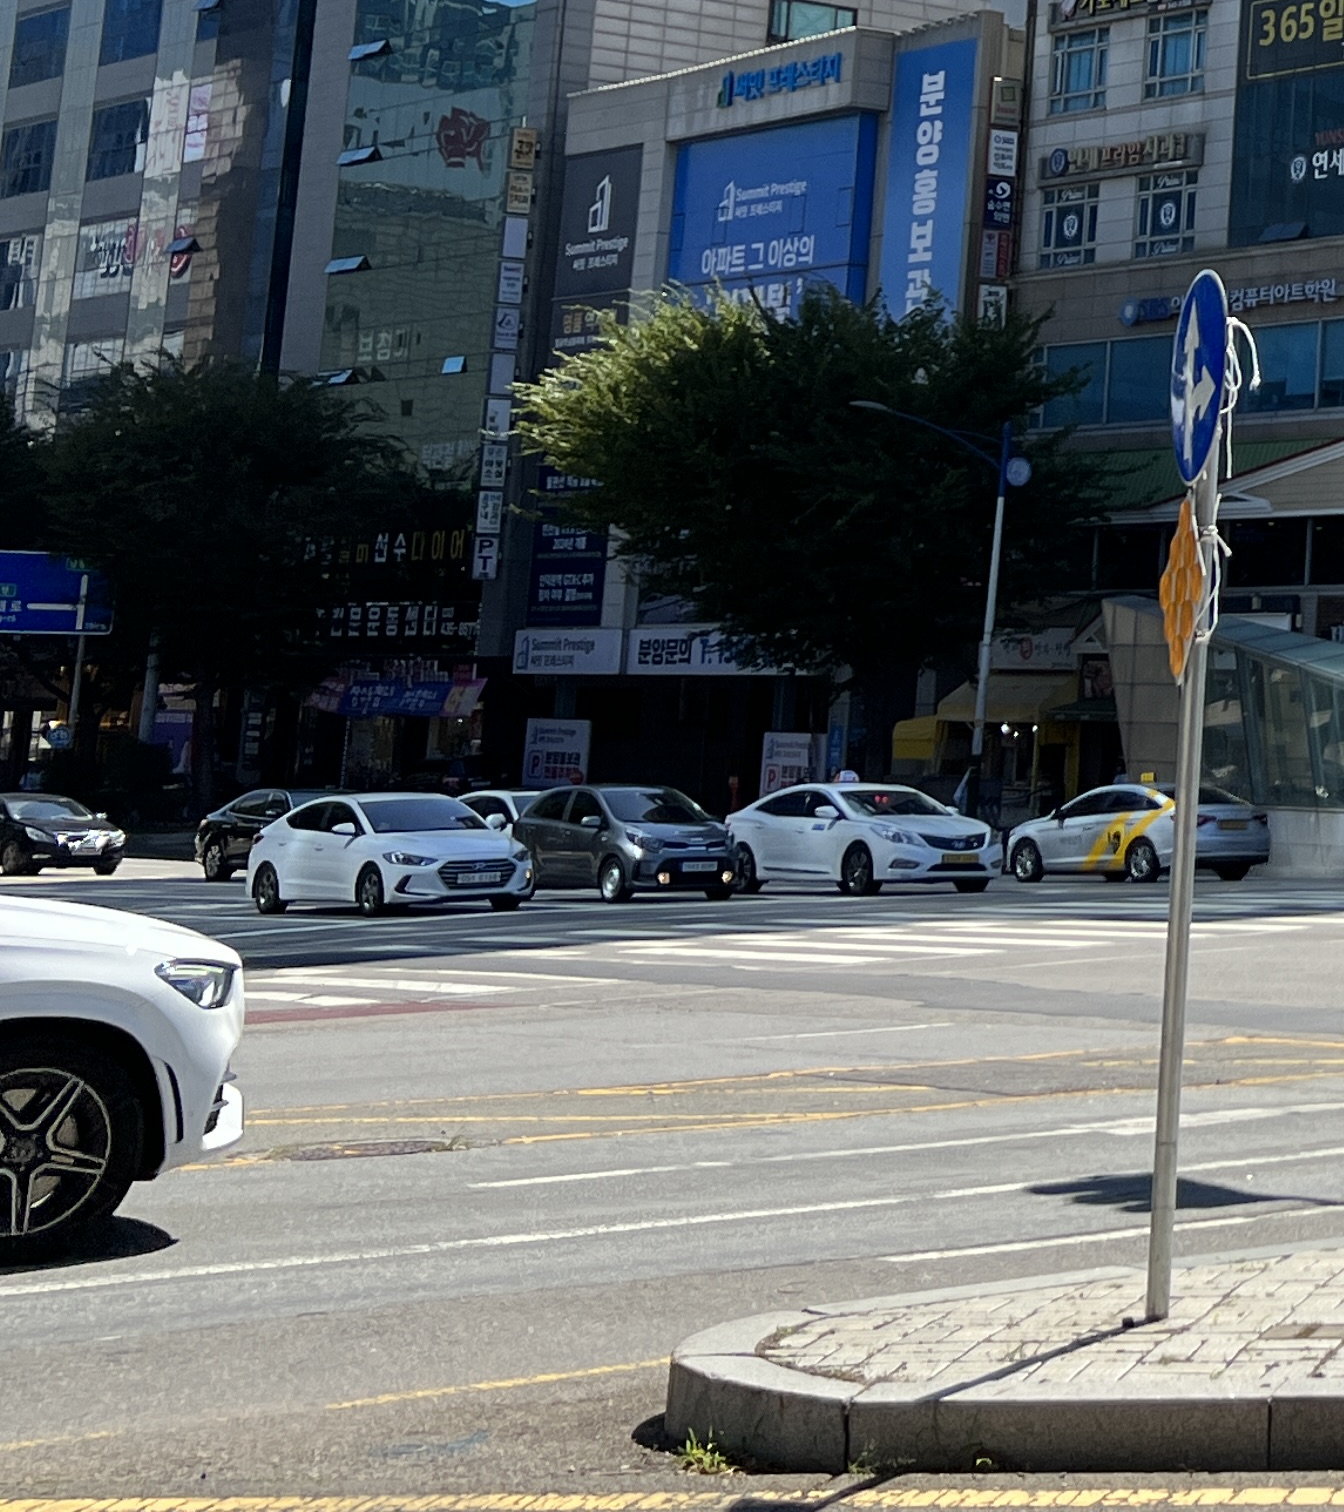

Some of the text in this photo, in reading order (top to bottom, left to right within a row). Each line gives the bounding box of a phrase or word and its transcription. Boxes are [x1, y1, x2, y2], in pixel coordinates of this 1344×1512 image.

[701, 235, 815, 276] 아파트 그 이상의
[638, 639, 692, 665] 분양문의
